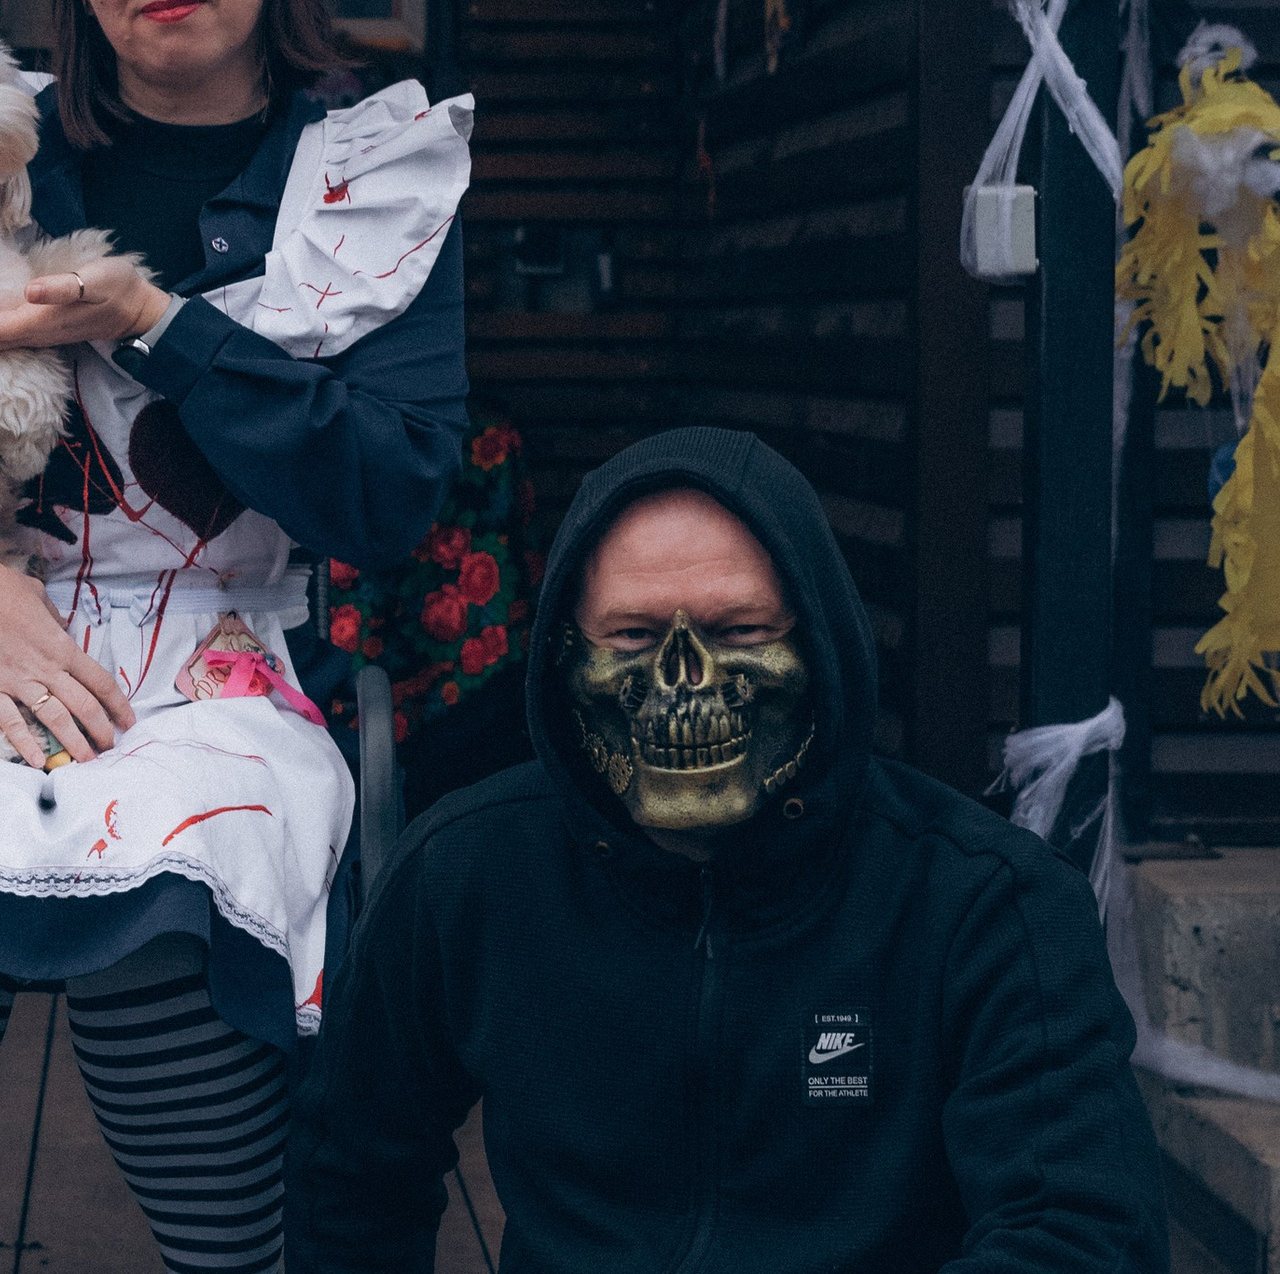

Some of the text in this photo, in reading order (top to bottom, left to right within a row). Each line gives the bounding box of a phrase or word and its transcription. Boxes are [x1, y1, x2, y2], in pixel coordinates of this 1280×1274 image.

[816, 1032, 855, 1050] NIKE
[807, 1076, 868, 1085] ONLY THE BEST
[808, 1089, 869, 1098] FOR THE ATHLETE
